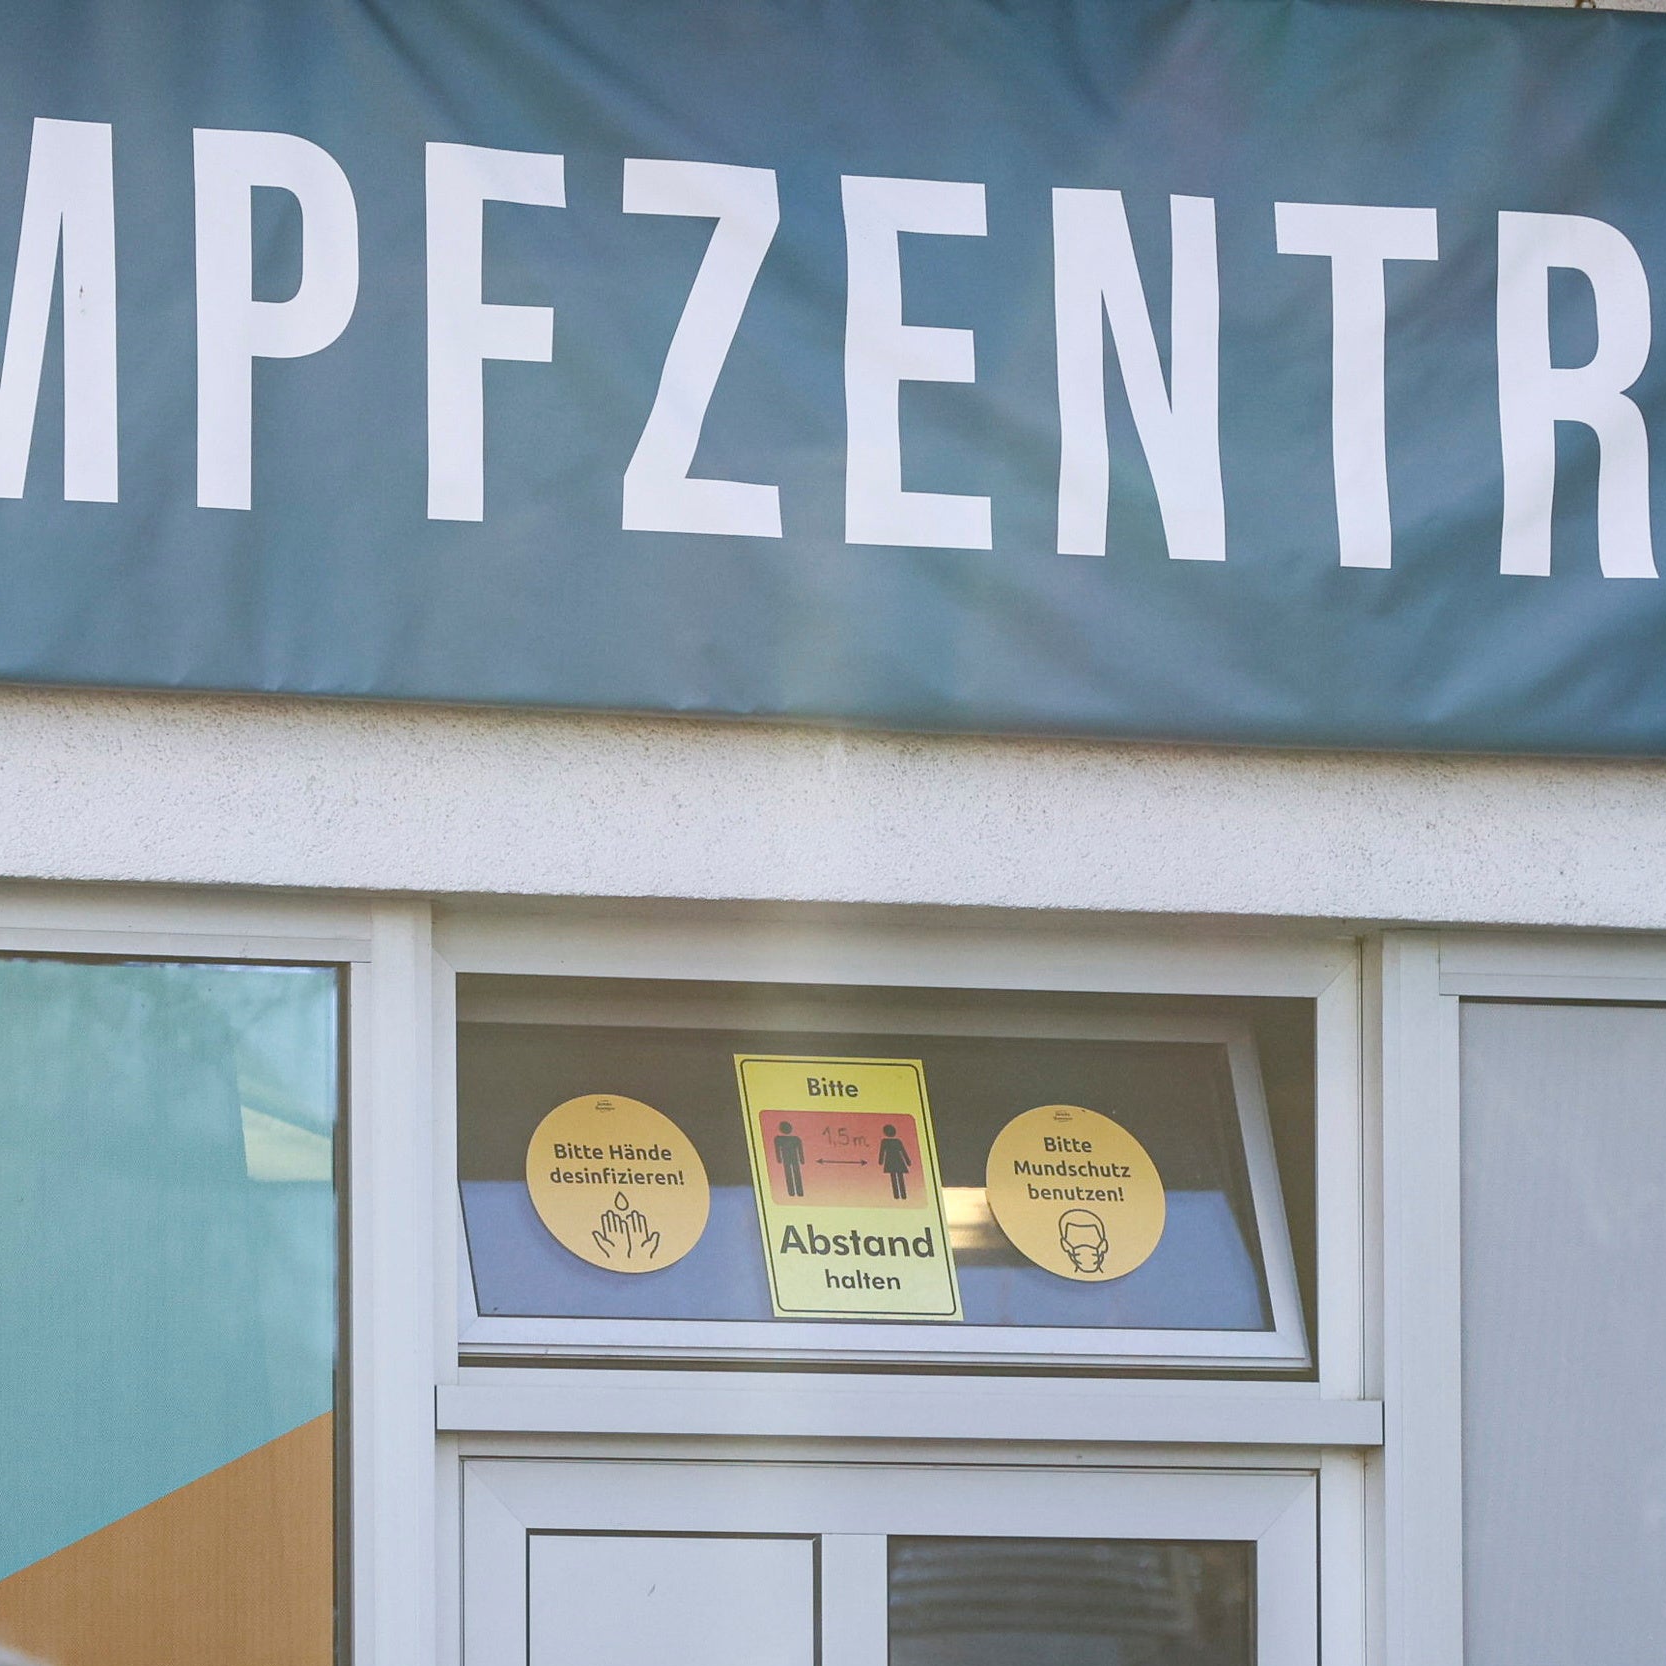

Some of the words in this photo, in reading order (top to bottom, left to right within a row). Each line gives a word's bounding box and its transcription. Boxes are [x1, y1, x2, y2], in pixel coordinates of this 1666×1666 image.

[806, 1077, 859, 1097] Bitte
[822, 1126, 850, 1146] 1,5
[1044, 1136, 1092, 1152] Bitte
[554, 1143, 603, 1160] Bitte
[609, 1144, 672, 1161] Hände
[550, 1167, 685, 1185] desinfizieren!
[1013, 1160, 1131, 1178] Mundschutz
[1027, 1183, 1125, 1202] benutzen!
[780, 1224, 935, 1258] Abstand
[825, 1268, 901, 1290] halten
